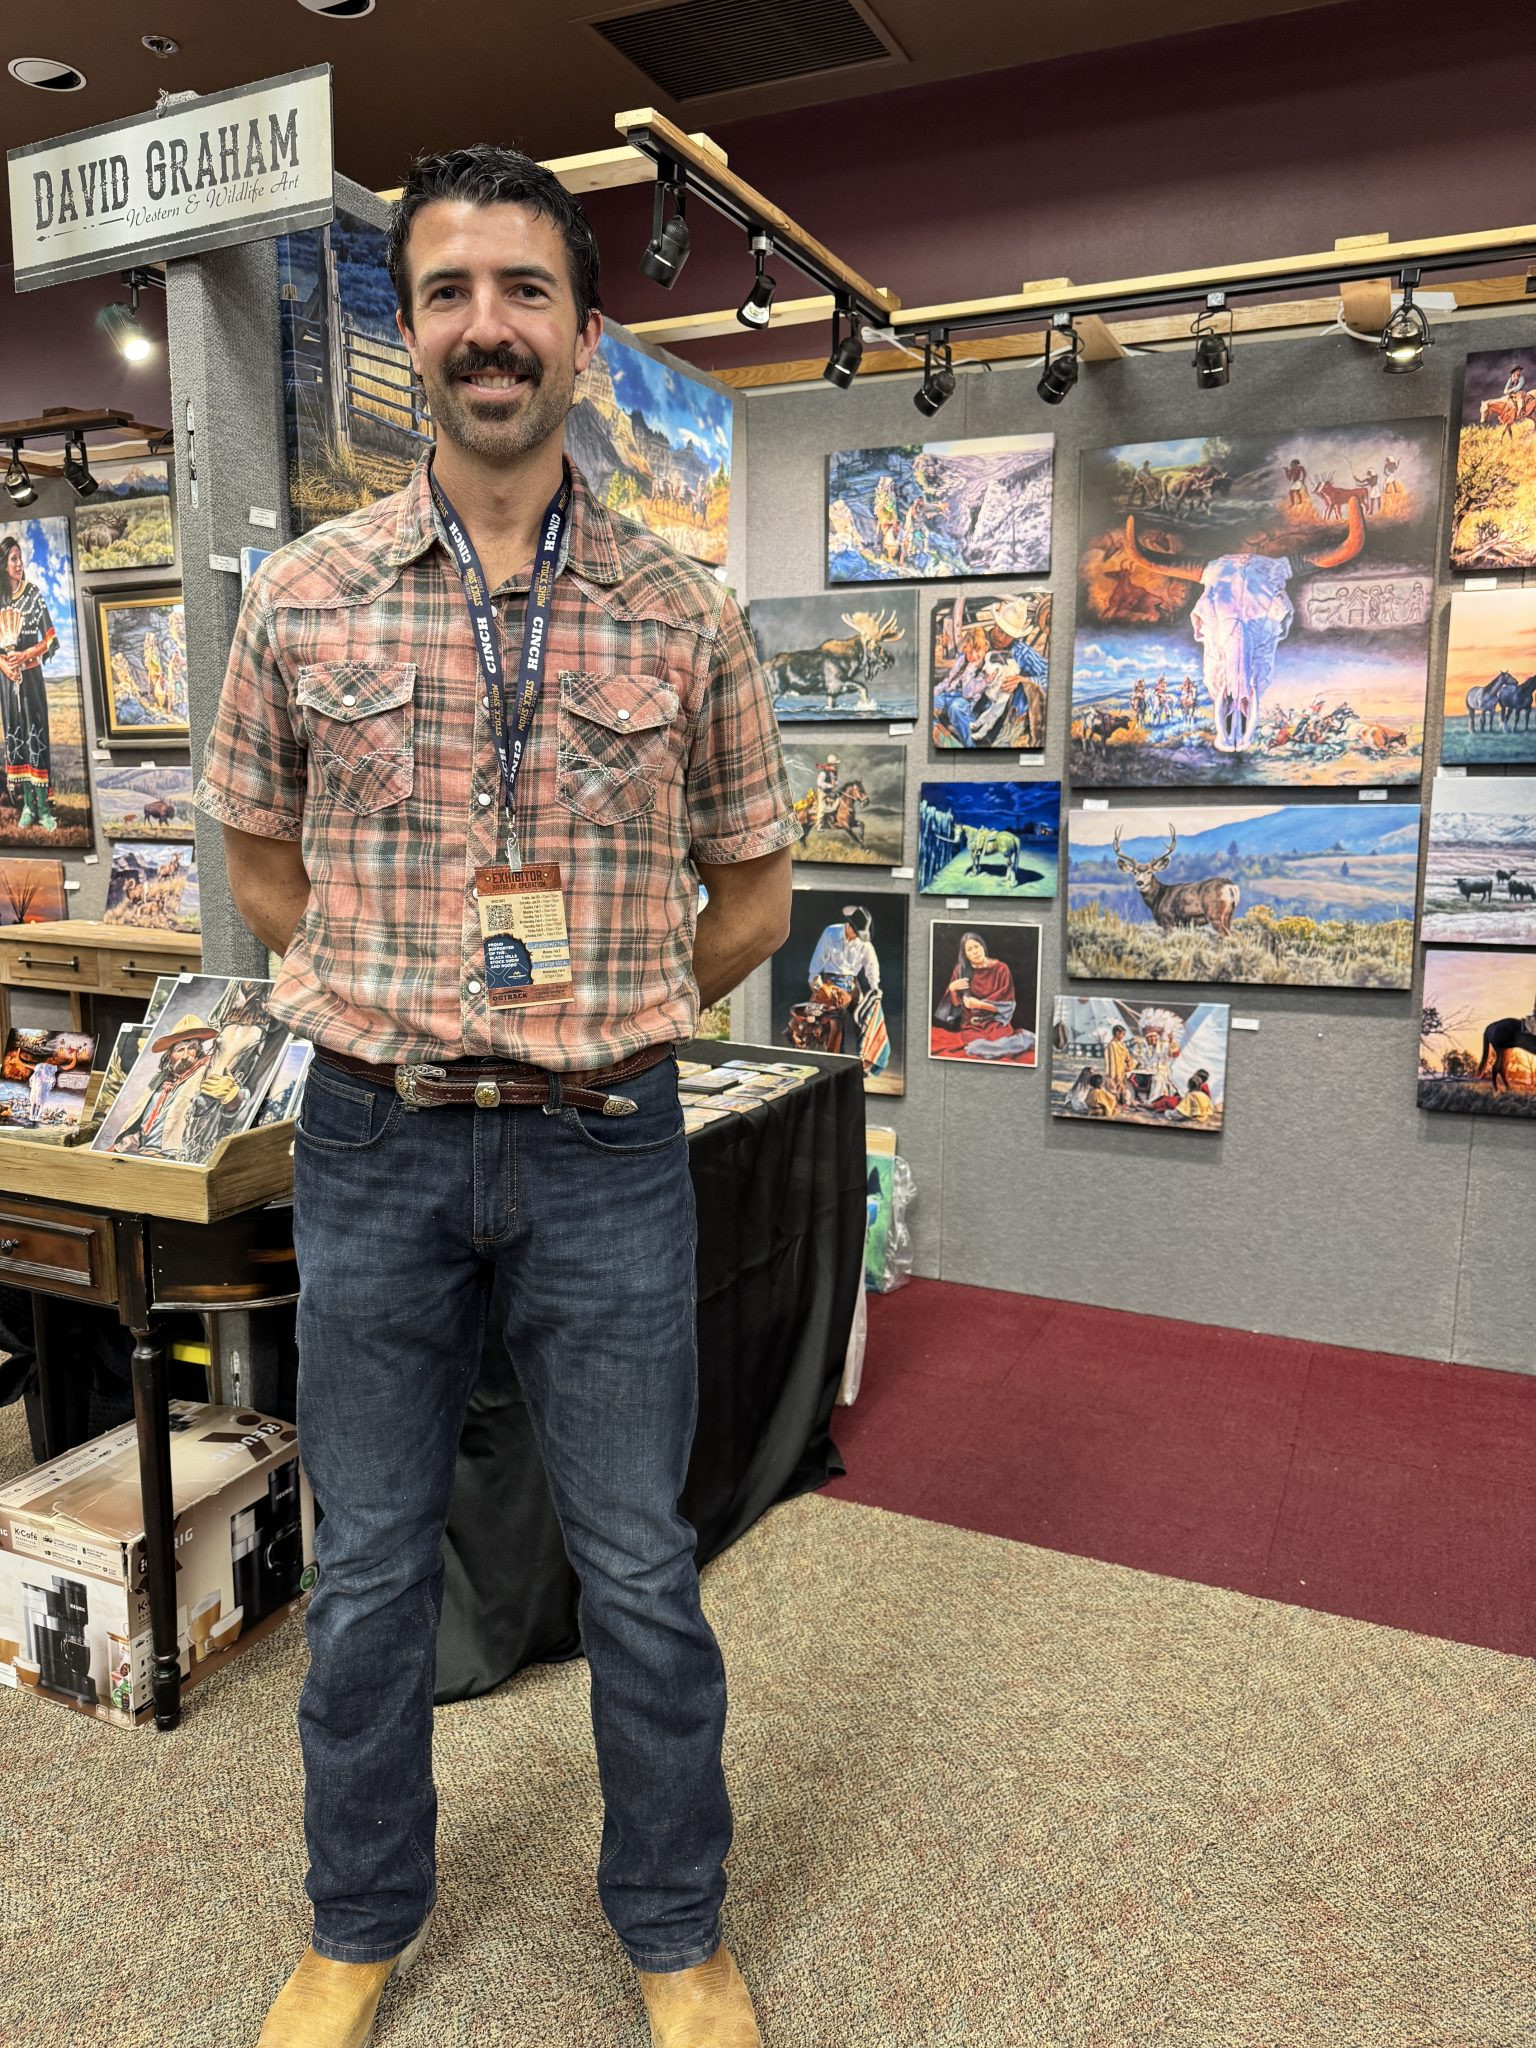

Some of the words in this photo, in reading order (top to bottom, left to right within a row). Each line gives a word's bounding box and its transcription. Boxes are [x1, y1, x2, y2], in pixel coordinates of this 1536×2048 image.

[33, 154, 129, 230] DAVID
[146, 108, 300, 201] GRAHAM
[126, 206, 180, 228] Western
[185, 193, 201, 214] &
[206, 181, 265, 209] Wildlife
[270, 171, 300, 194] Art
[448, 521, 472, 564] CINCH
[544, 513, 561, 552] CINCH
[540, 560, 551, 583] STOCK
[470, 586, 483, 607] STOCK
[536, 585, 547, 608] SHOW
[476, 616, 496, 674] CINCH
[526, 616, 544, 671] CINCH
[491, 683, 500, 708] SHOW
[523, 679, 534, 707] STOCK
[493, 710, 502, 737] STOCK
[517, 708, 529, 732] SHOW
[509, 740, 522, 784] CINC
[492, 870, 543, 884] EXHIBITOR
[518, 881, 546, 889] OPERATION
[493, 993, 528, 1001] OUTBACK
[210, 1423, 281, 1462] KEURIG
